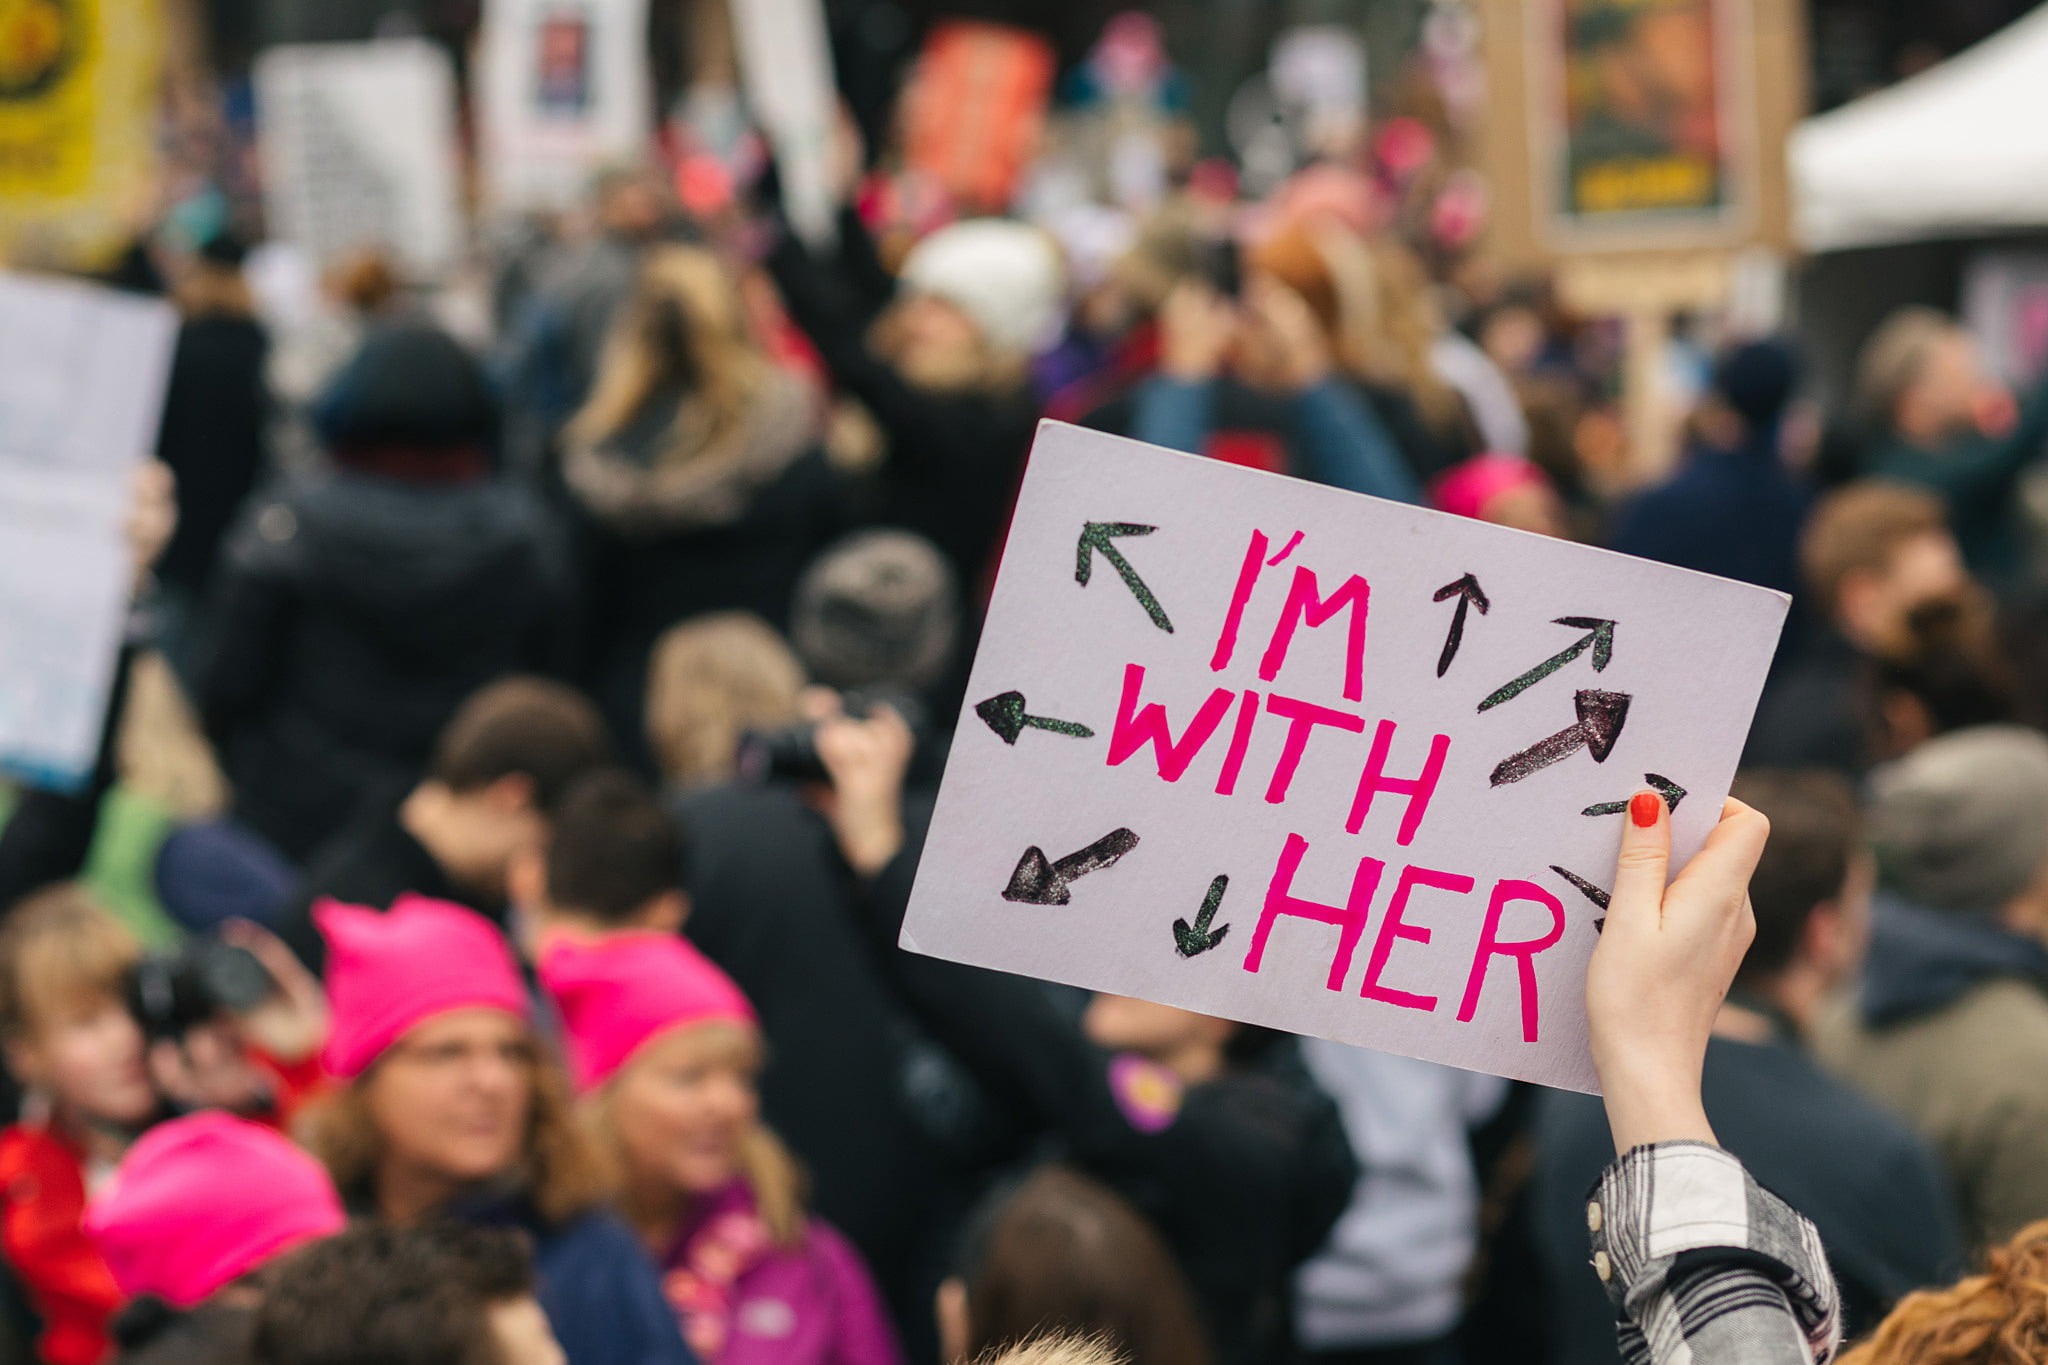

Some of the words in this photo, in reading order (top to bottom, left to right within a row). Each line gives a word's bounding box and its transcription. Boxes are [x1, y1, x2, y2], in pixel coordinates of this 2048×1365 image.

[1209, 528, 1371, 703] I'M
[1105, 663, 1452, 847] WITH
[1242, 832, 1566, 1043] HER
